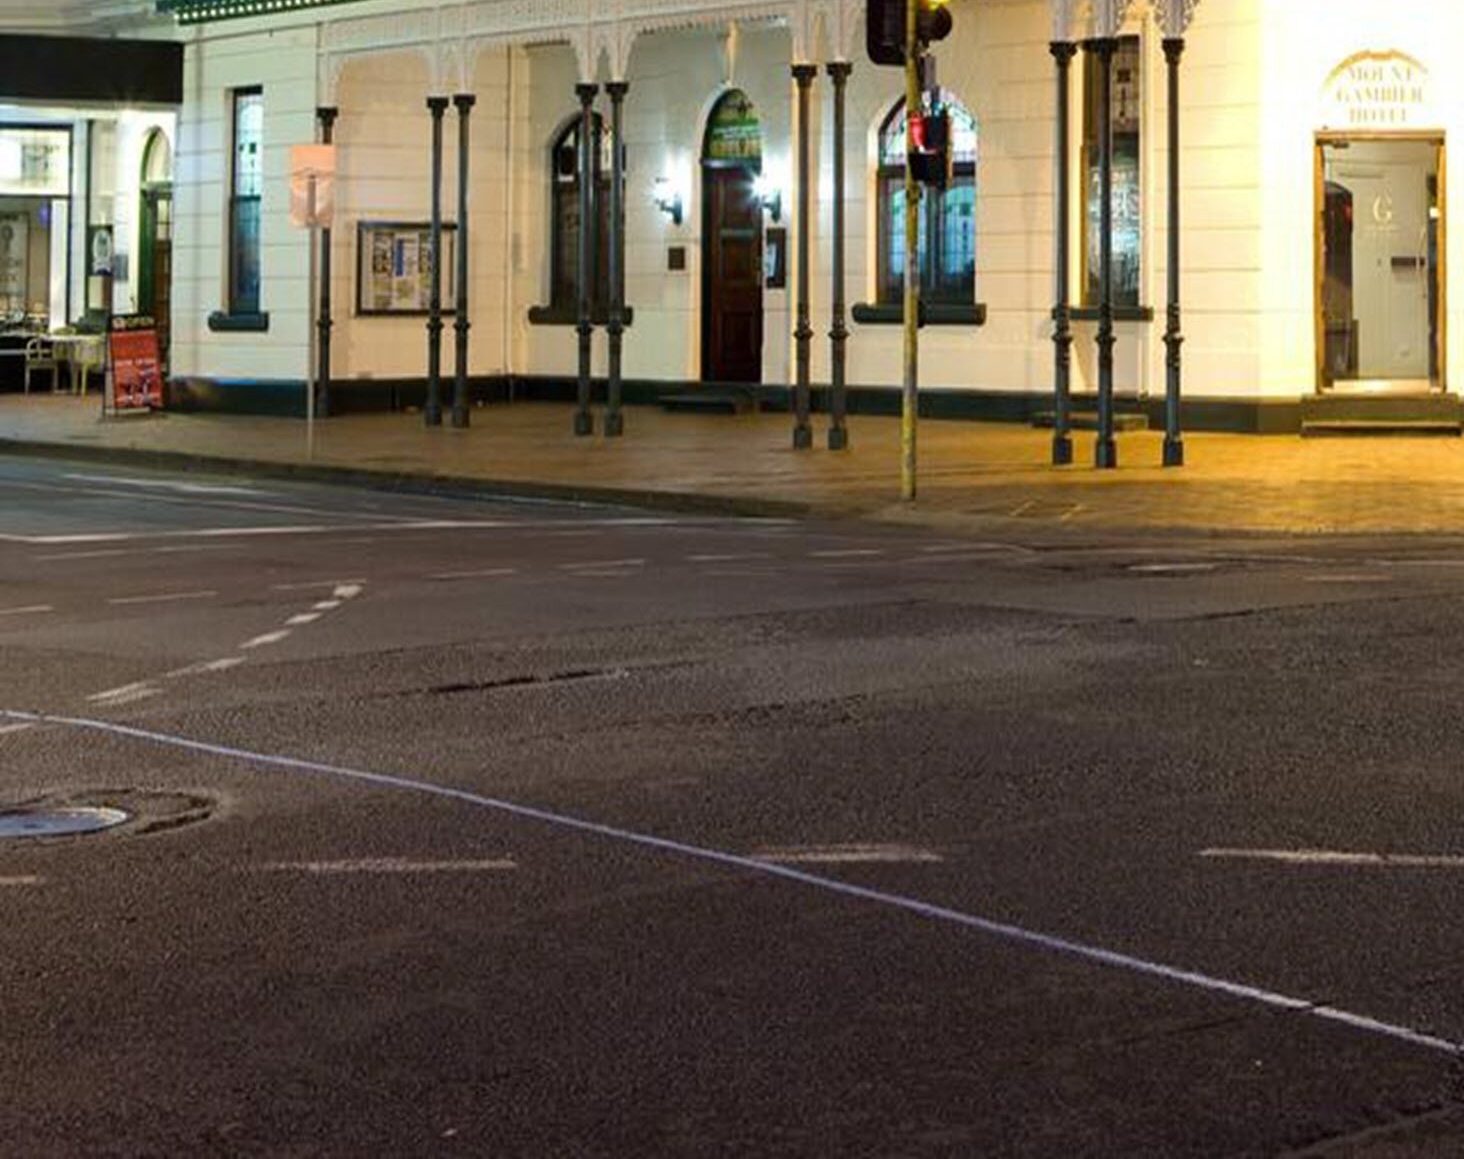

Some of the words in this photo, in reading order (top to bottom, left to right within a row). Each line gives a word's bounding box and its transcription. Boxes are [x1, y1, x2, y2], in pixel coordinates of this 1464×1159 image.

[1348, 64, 1413, 81] MOUNT
[1336, 85, 1423, 103] GAMBIER
[1348, 107, 1408, 123] HOTEL
